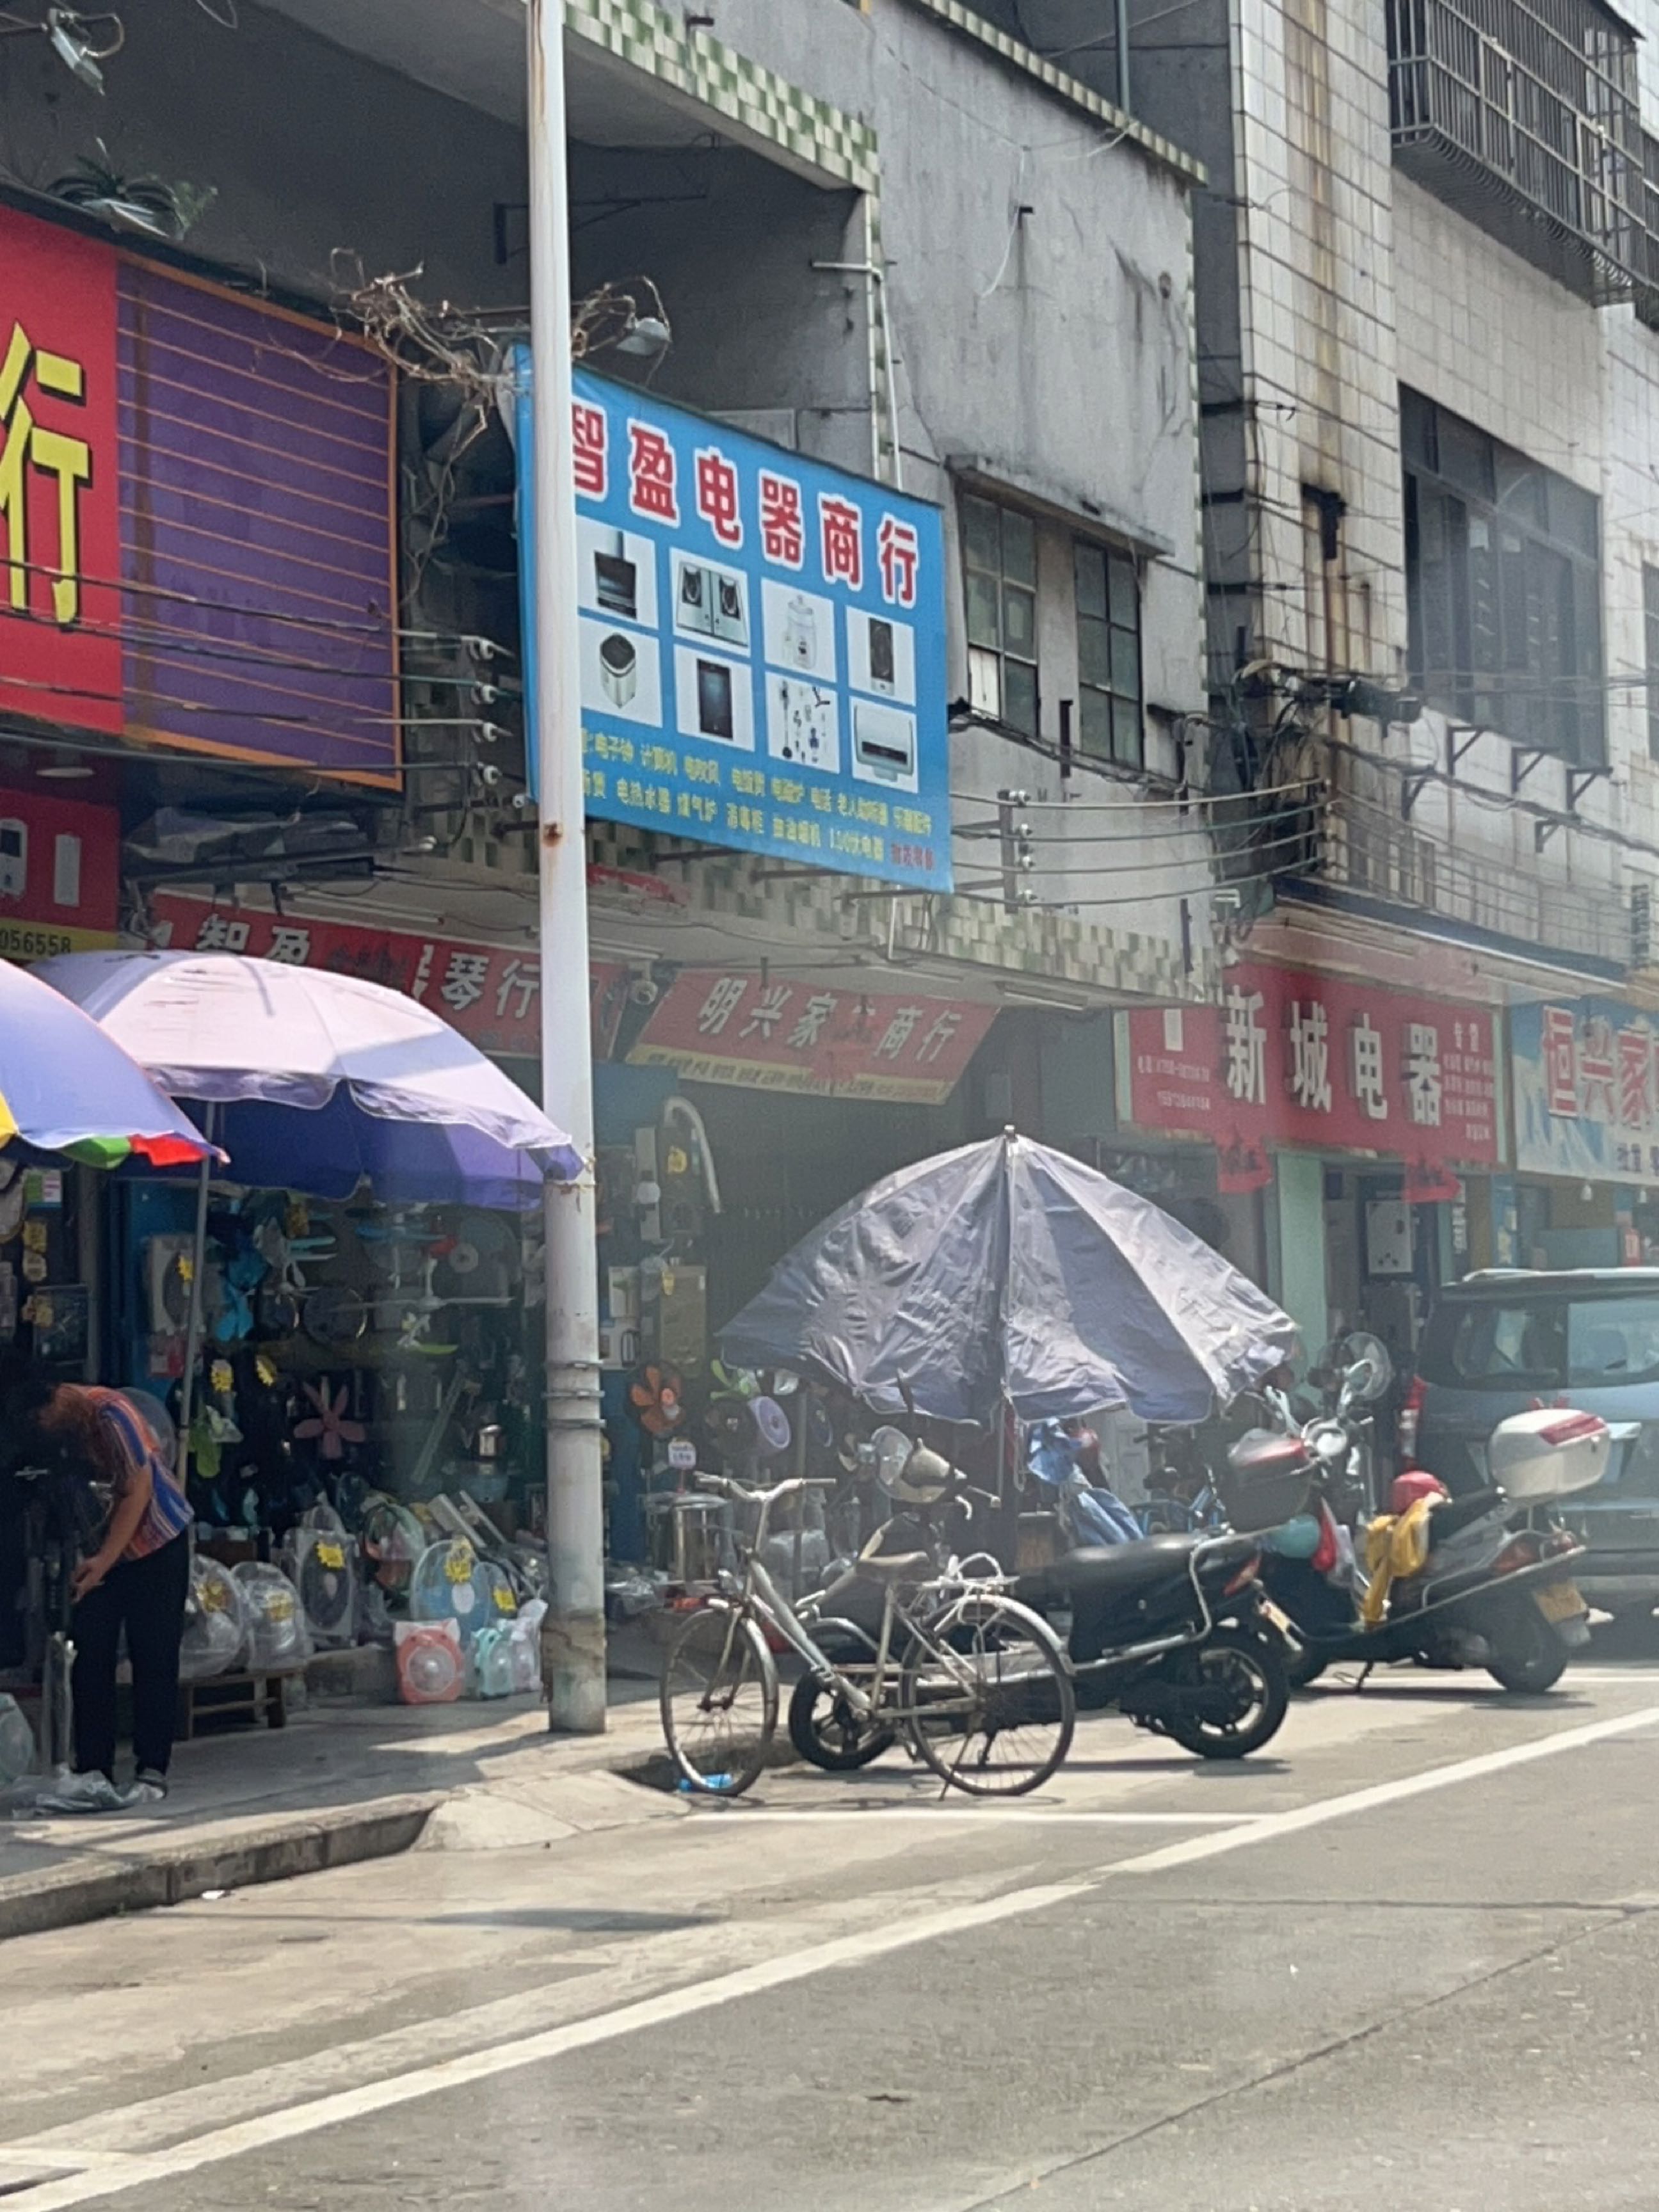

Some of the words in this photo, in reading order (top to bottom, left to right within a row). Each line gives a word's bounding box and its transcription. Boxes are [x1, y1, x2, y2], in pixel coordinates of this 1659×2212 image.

[0, 320, 89, 625] 行
[571, 397, 919, 607] 智盈电器商行
[698, 977, 963, 1062] 明兴家商行
[1226, 984, 1442, 1126] 新城电器
